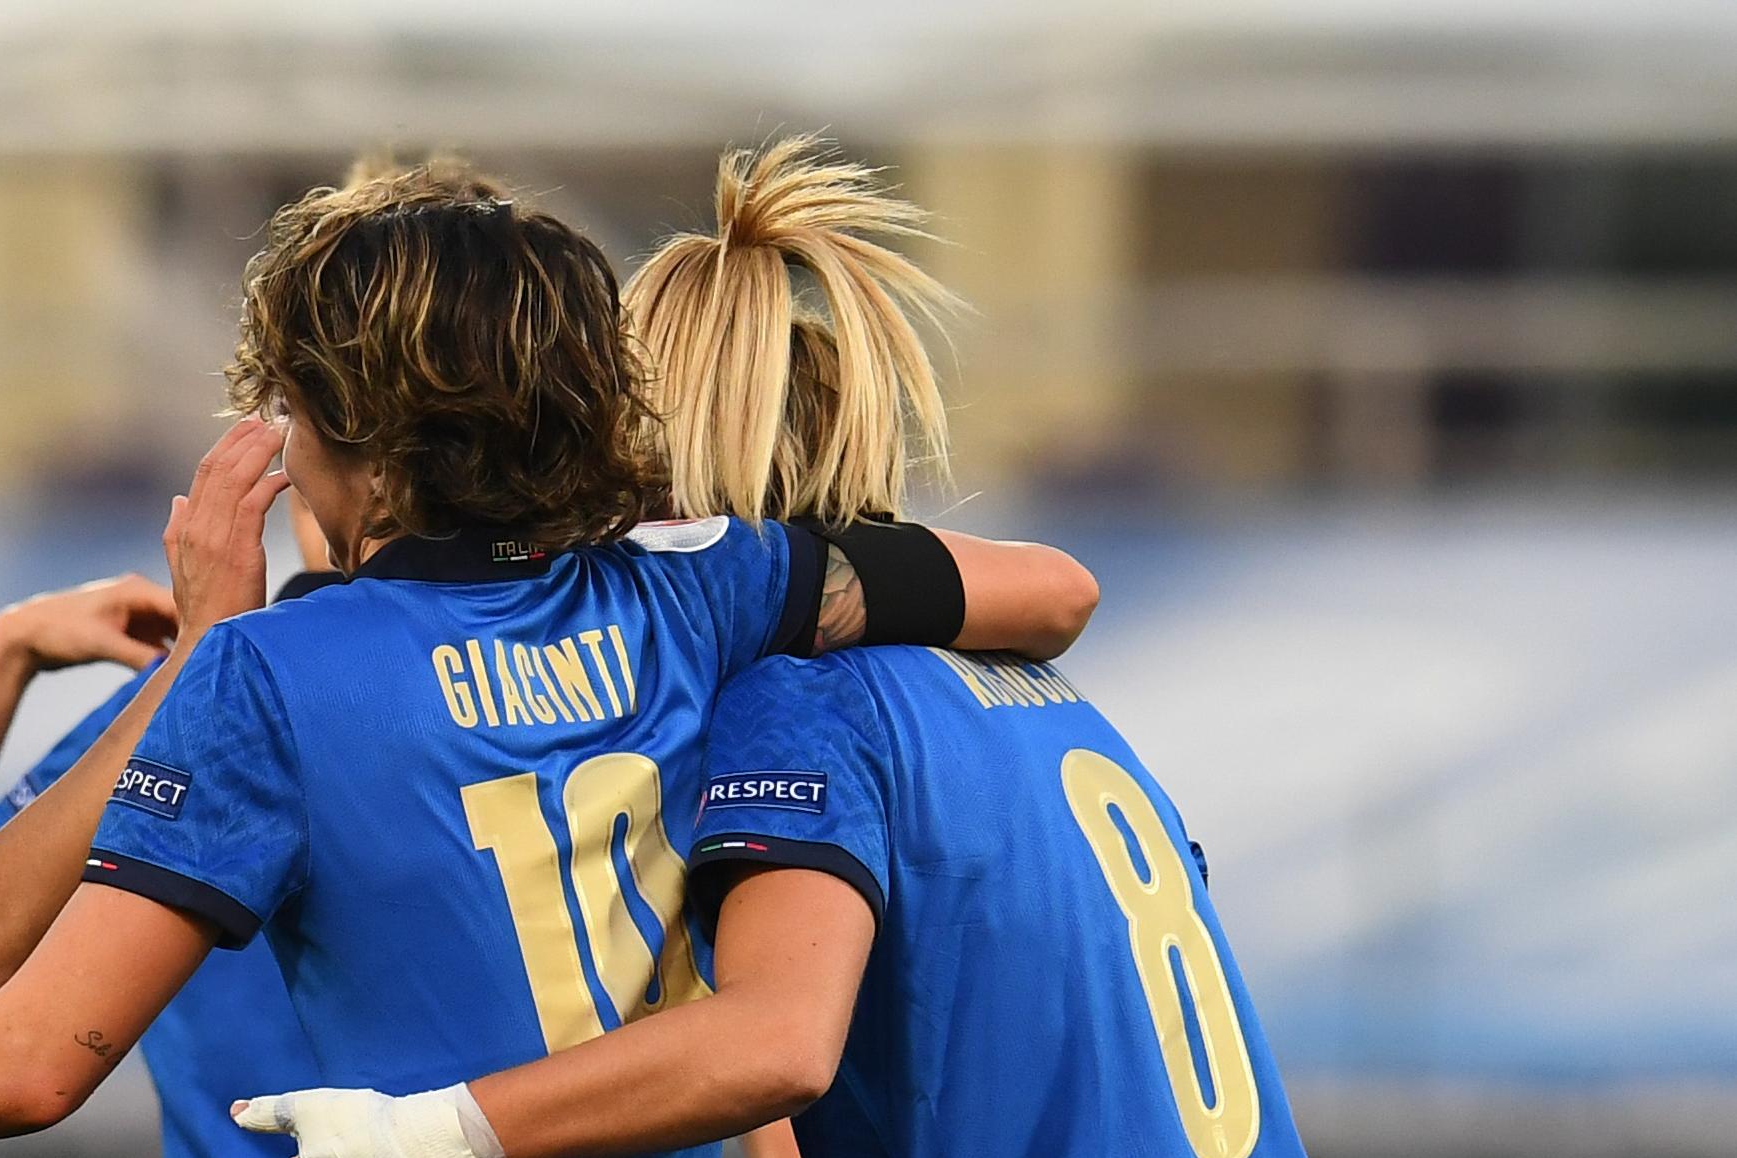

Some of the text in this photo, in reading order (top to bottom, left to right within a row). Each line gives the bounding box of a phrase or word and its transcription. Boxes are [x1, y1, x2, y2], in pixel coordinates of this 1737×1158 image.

[432, 624, 637, 729] GIACINTI
[114, 768, 186, 805] SPECT
[710, 780, 825, 801] RESPECT
